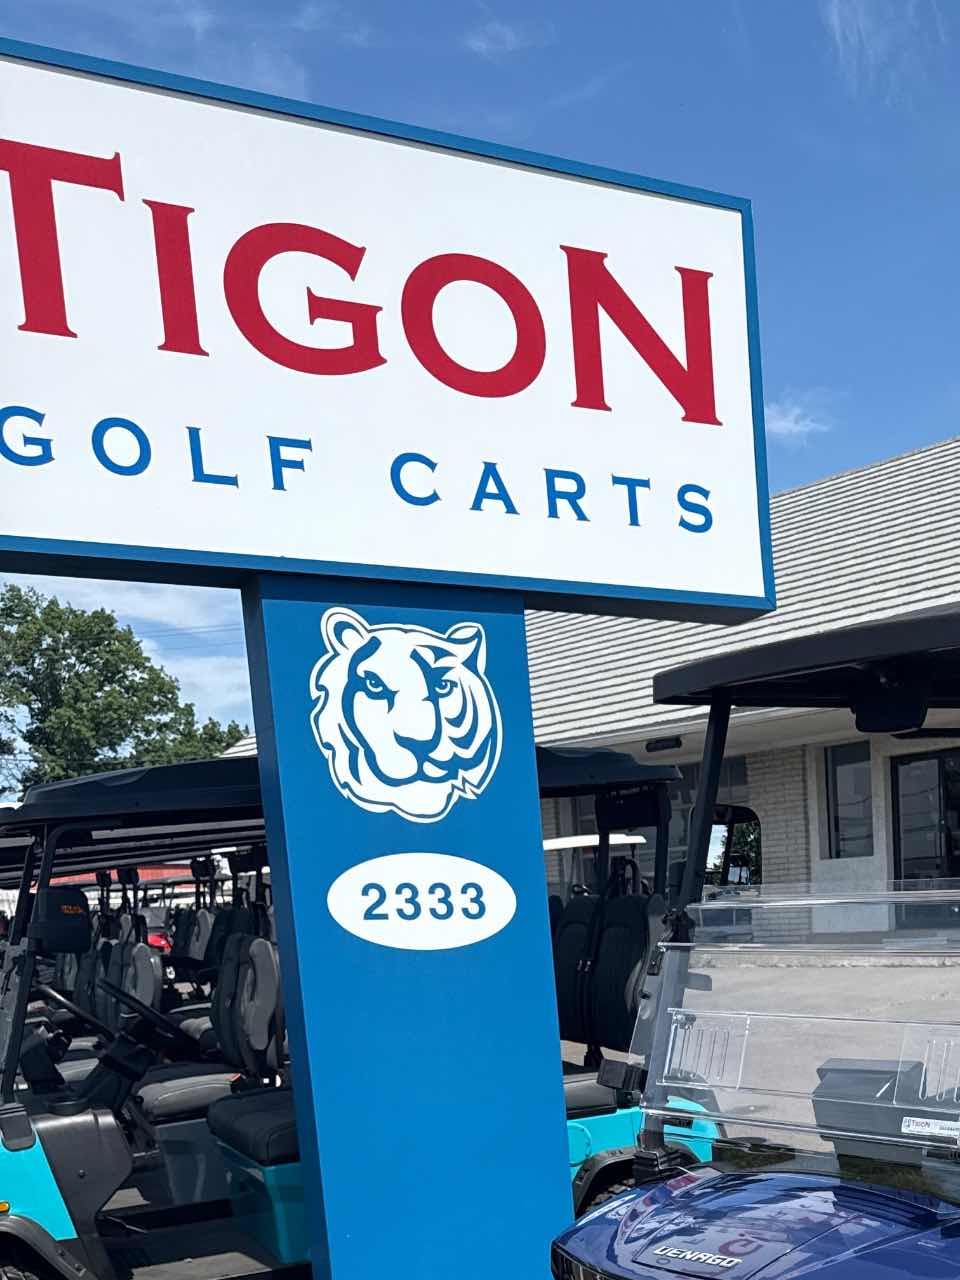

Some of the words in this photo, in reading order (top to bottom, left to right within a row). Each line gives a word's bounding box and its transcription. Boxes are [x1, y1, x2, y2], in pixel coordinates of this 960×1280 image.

[0, 138, 722, 426] TIGON
[0, 405, 313, 491] GOLF
[390, 452, 714, 534] CARTS
[360, 882, 487, 921] 2333
[653, 1245, 743, 1268] DENAGO
